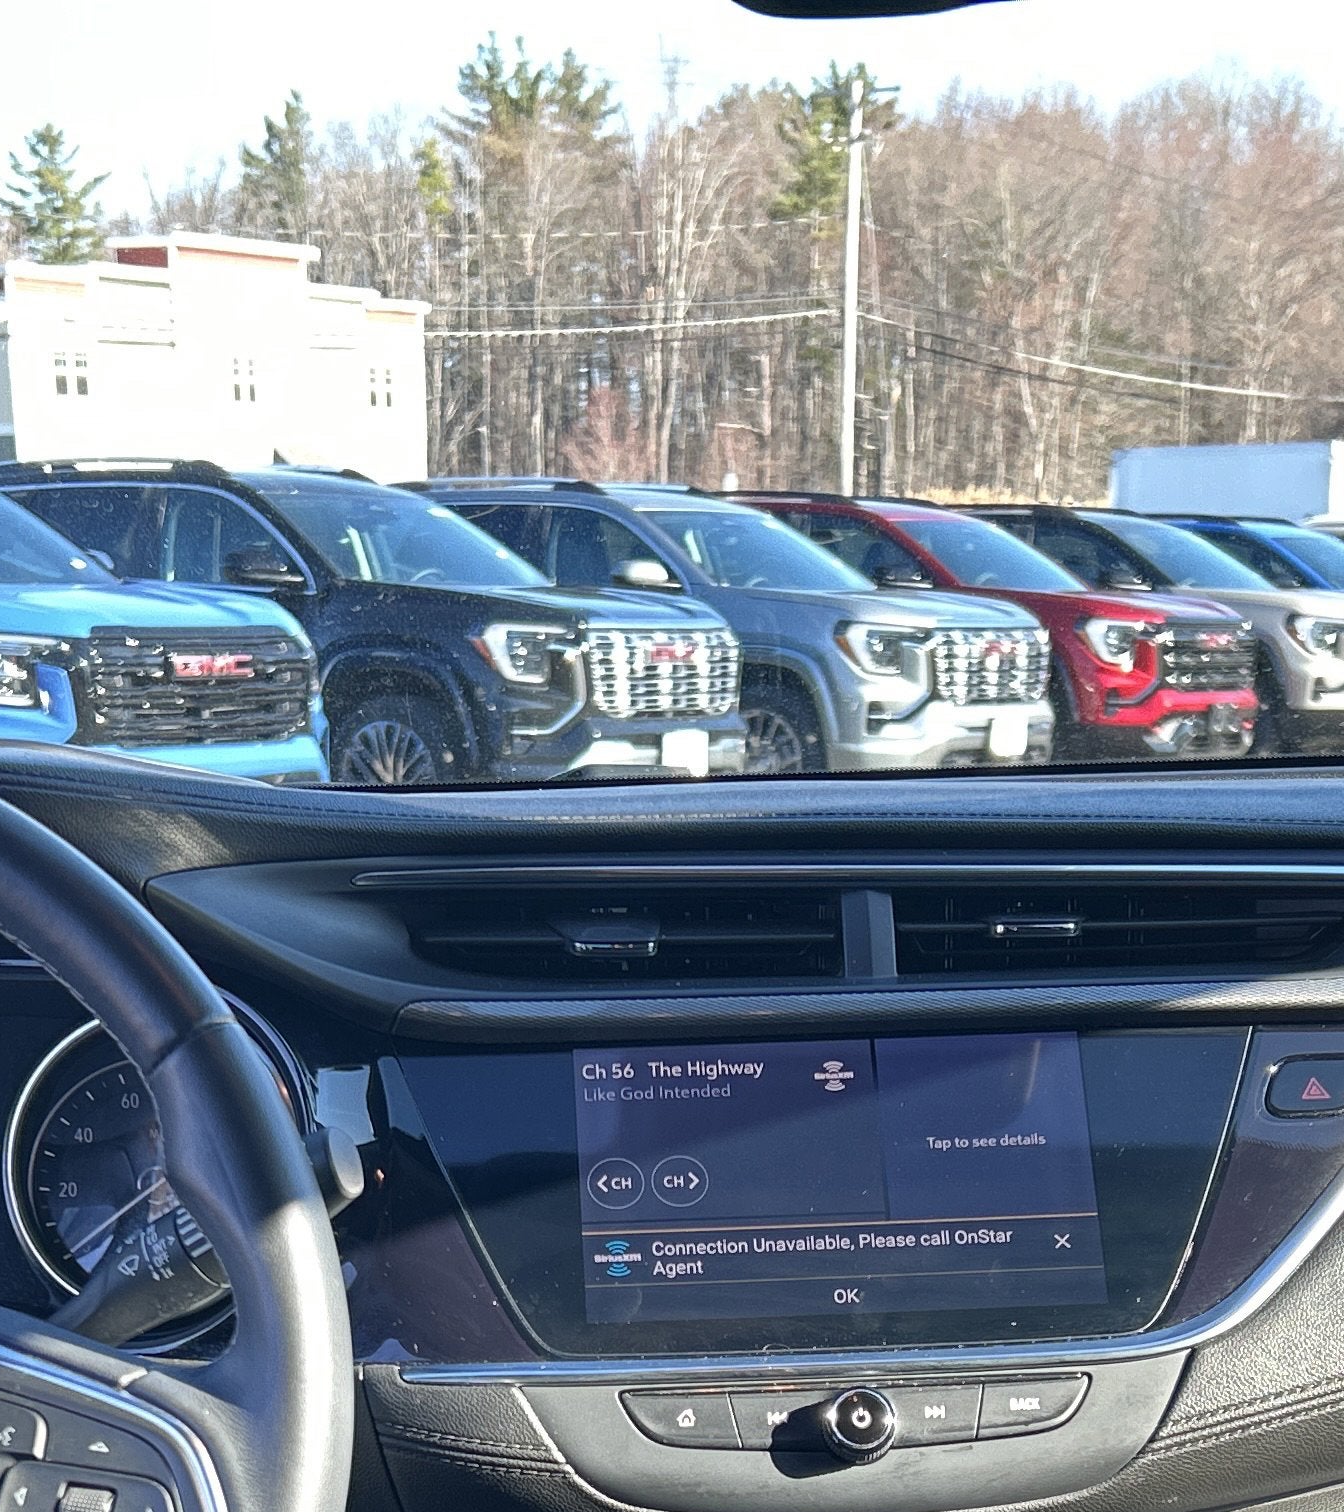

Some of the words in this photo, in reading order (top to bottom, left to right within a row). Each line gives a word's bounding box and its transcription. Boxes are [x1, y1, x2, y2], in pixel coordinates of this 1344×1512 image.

[172, 654, 254, 677] GMC
[582, 1063, 606, 1080] Ch
[612, 1063, 635, 1079] 56
[648, 1062, 682, 1078] The
[687, 1059, 765, 1080] Highway
[121, 1092, 140, 1109] 60
[584, 1086, 616, 1102] Like
[620, 1085, 654, 1100] God
[659, 1083, 731, 1099] Intended
[74, 1127, 93, 1143] 40
[926, 1136, 952, 1151] Tap
[954, 1136, 969, 1148] to
[972, 1137, 997, 1148] see
[1000, 1132, 1047, 1146] details
[58, 1182, 78, 1198] 20
[611, 1177, 632, 1190] CH
[663, 1175, 684, 1188] CH
[652, 1238, 748, 1257] Connection
[753, 1234, 855, 1253] Unavailable,
[858, 1232, 916, 1249] Please
[920, 1230, 950, 1246] call
[955, 1229, 1013, 1245] OnStar
[653, 1260, 704, 1279] Agent
[833, 1288, 860, 1304] OK
